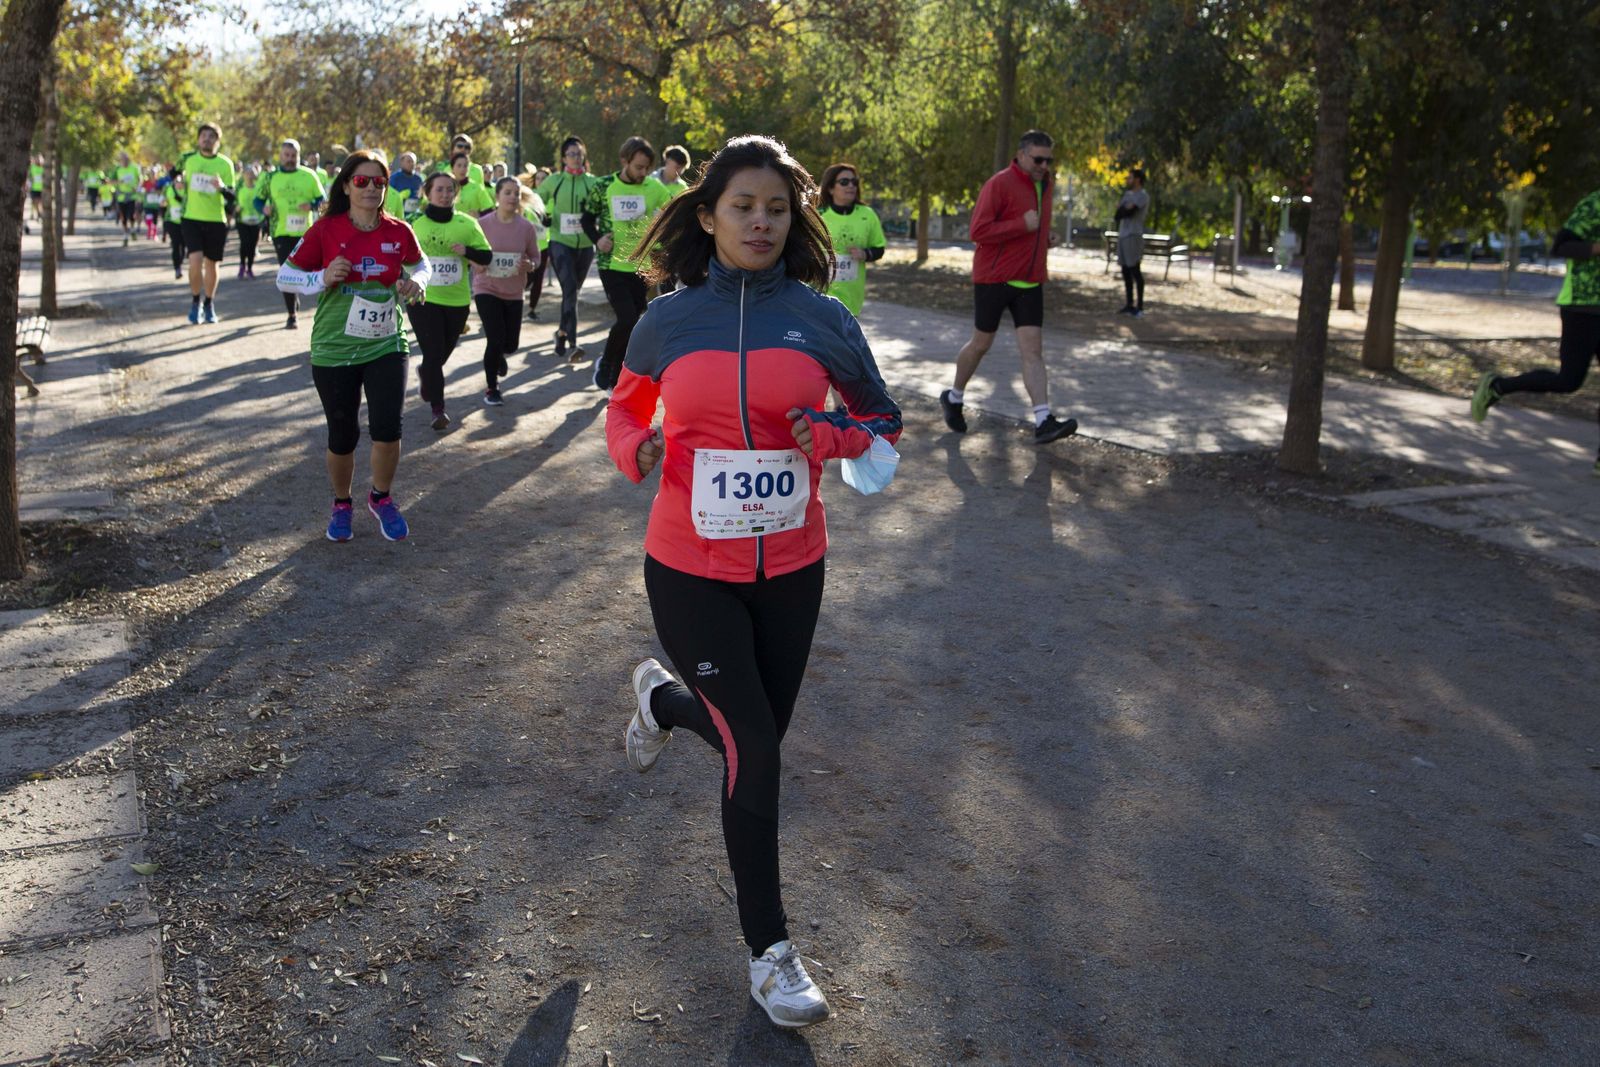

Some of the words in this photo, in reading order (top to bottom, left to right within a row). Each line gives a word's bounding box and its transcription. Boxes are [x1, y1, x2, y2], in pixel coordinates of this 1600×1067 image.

[620, 201, 638, 209] 700
[495, 258, 514, 267] 198
[432, 263, 458, 273] 1206
[358, 308, 393, 322] 1311
[712, 470, 795, 499] 1300
[742, 503, 764, 512] ELSA
